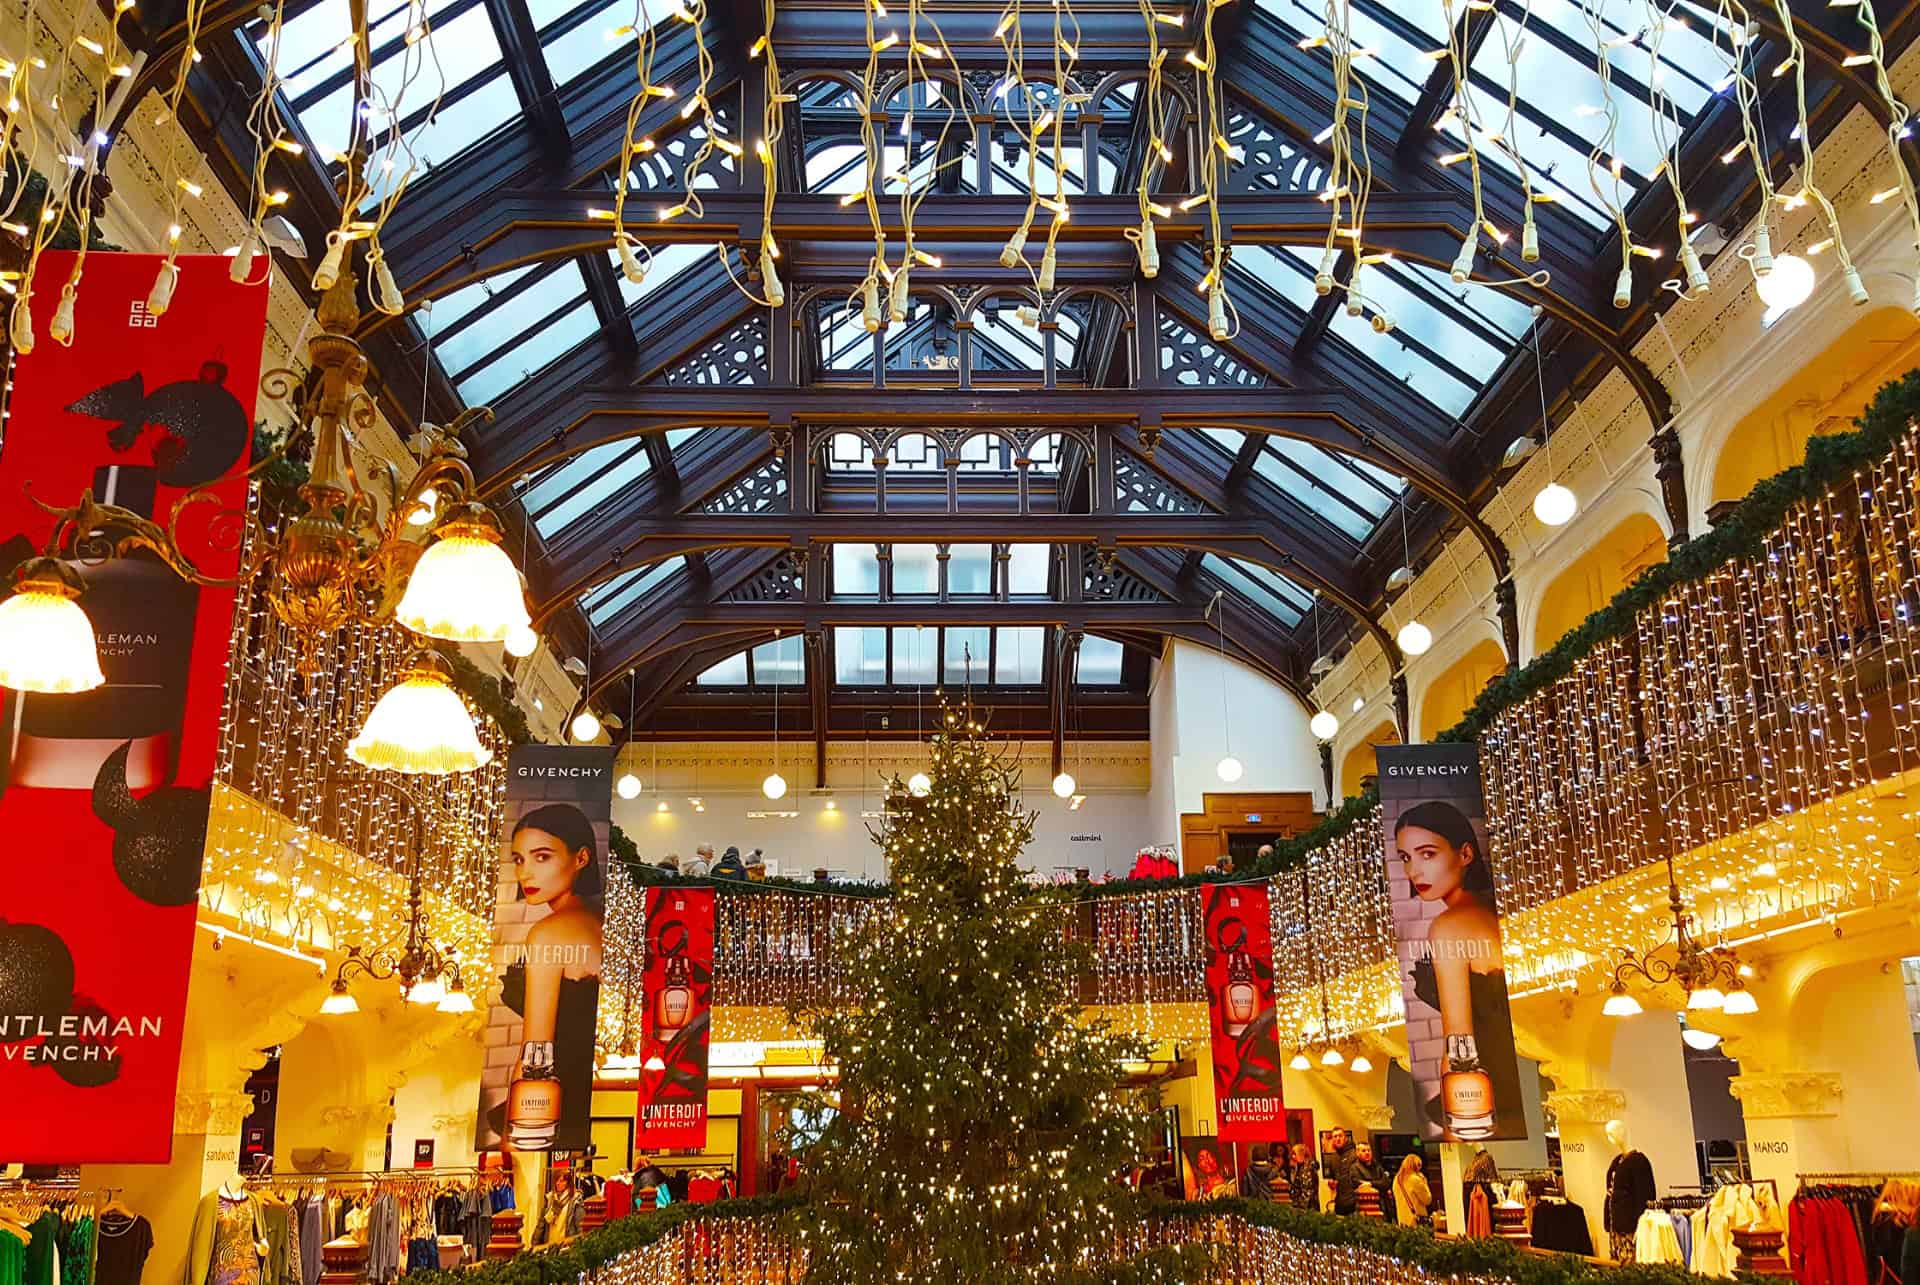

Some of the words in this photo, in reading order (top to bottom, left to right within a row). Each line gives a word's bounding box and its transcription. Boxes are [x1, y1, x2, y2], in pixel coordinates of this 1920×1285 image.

[518, 767, 602, 777] GIVENCHY
[1388, 766, 1469, 776] GIVENCHY
[503, 943, 591, 964] L'INTERDIT
[1408, 940, 1492, 960] L'INTERDIT
[4, 1045, 118, 1061] VENCHY
[641, 1103, 703, 1120] L'INTERDIT
[1220, 1097, 1280, 1113] L'INTERDIT
[645, 1120, 696, 1129] GIVENCHY
[1225, 1114, 1275, 1122] GIVENCHY
[1563, 1143, 1585, 1153] MANGO
[1753, 1141, 1789, 1154] MANGO
